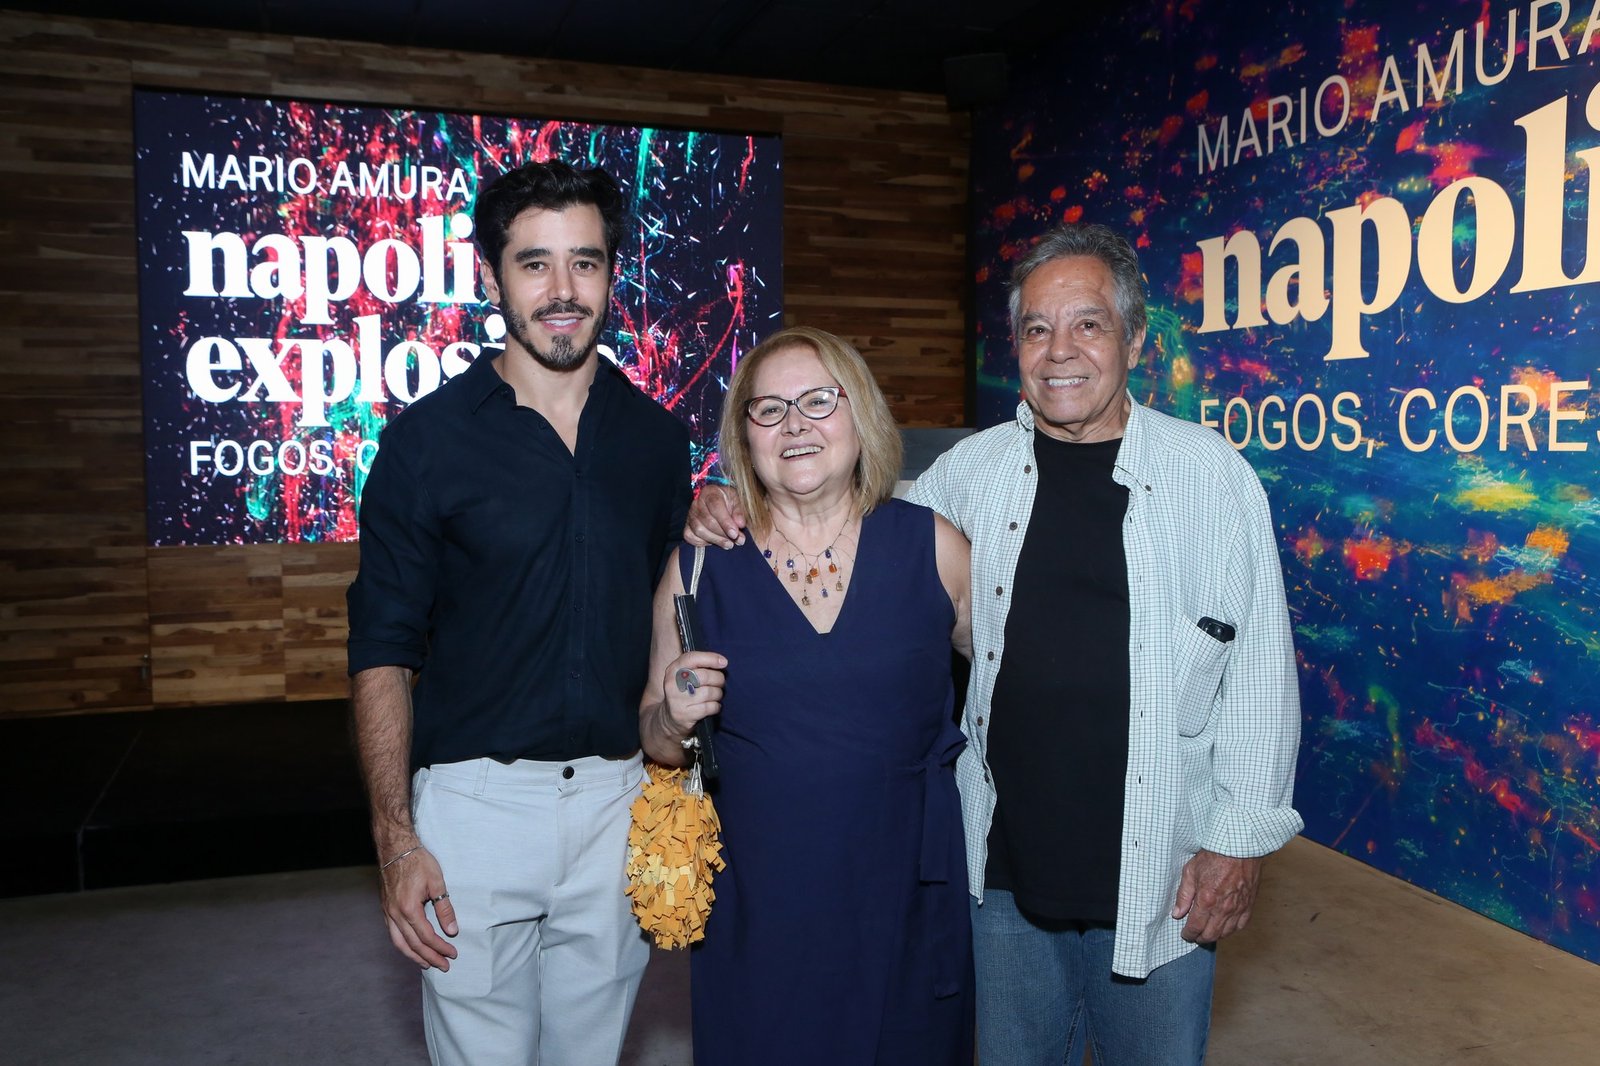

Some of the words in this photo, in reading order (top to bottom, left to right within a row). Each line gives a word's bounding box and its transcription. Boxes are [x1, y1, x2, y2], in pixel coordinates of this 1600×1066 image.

[1197, 73, 1351, 175] MARIO
[182, 152, 317, 194] MARIO
[330, 161, 471, 202] AMURA
[182, 213, 480, 325] napoli
[1399, 380, 1600, 453] CORE
[190, 440, 345, 478] FOGOS,
